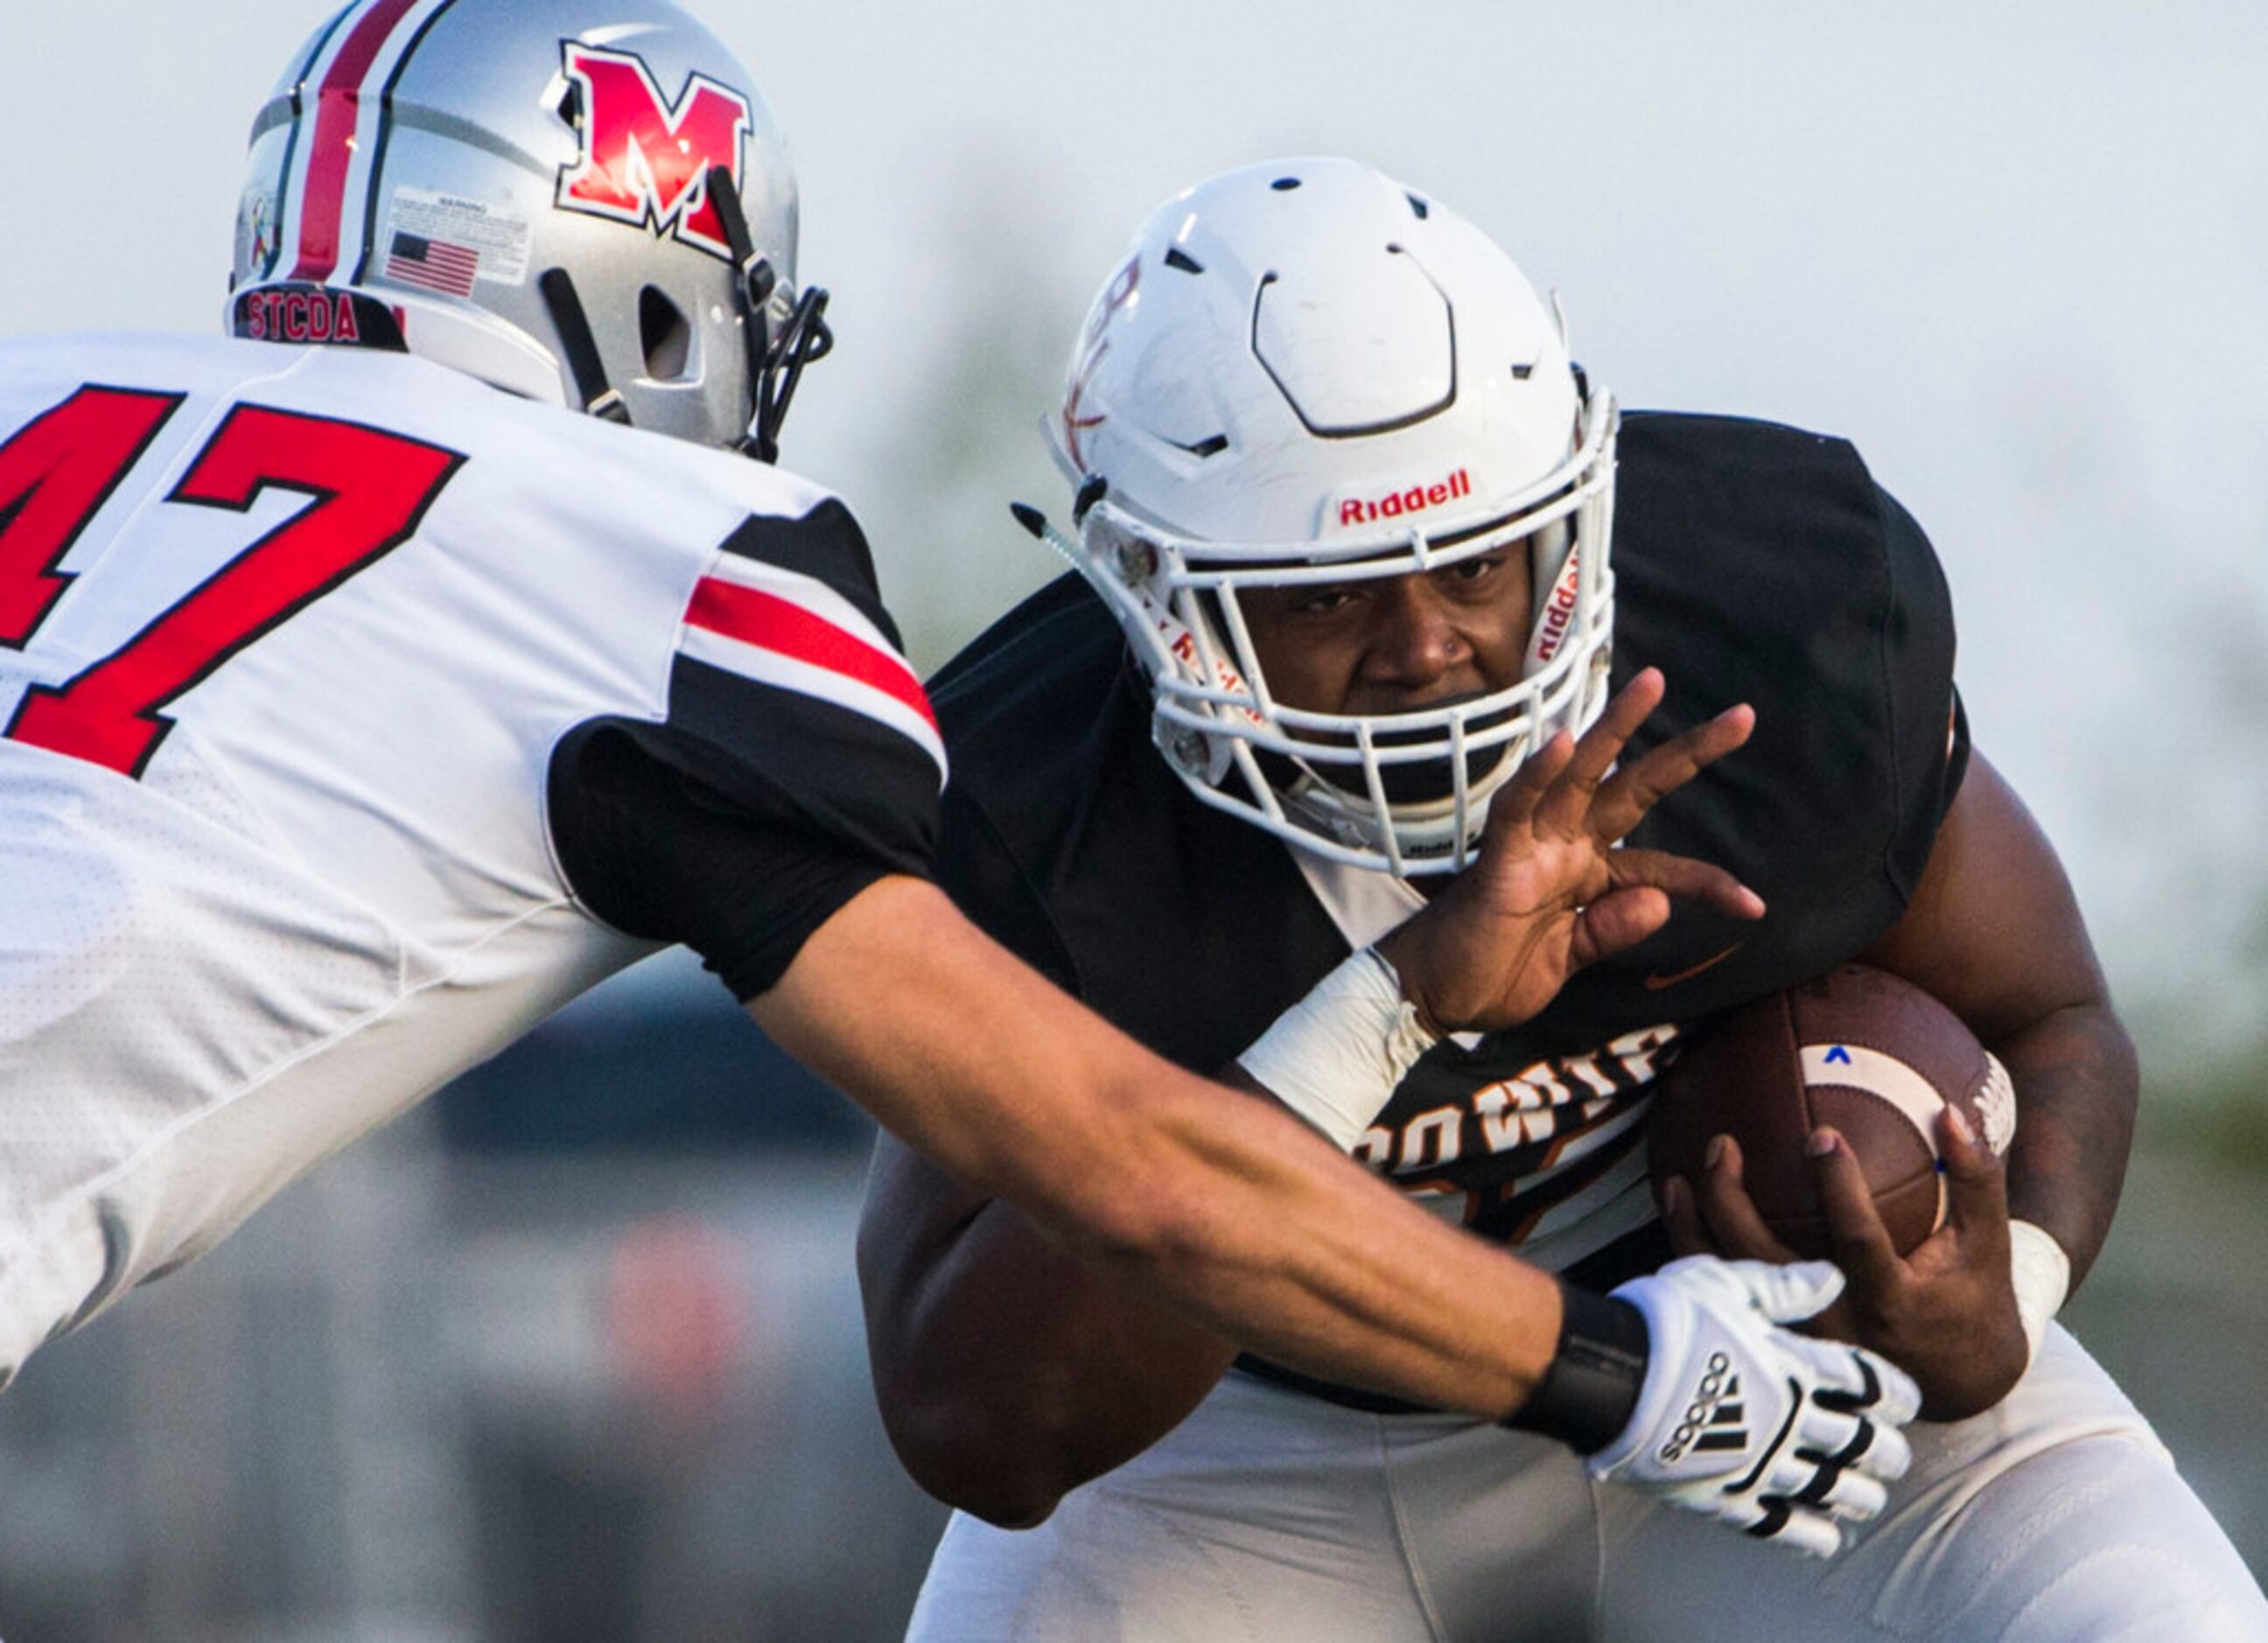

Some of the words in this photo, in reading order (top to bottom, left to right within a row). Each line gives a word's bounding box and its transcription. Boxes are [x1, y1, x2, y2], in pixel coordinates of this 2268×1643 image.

[555, 38, 753, 260] M
[248, 292, 360, 342] STCDA
[1340, 469, 1471, 526] Riddell
[1661, 1352, 1730, 1463] adidas
